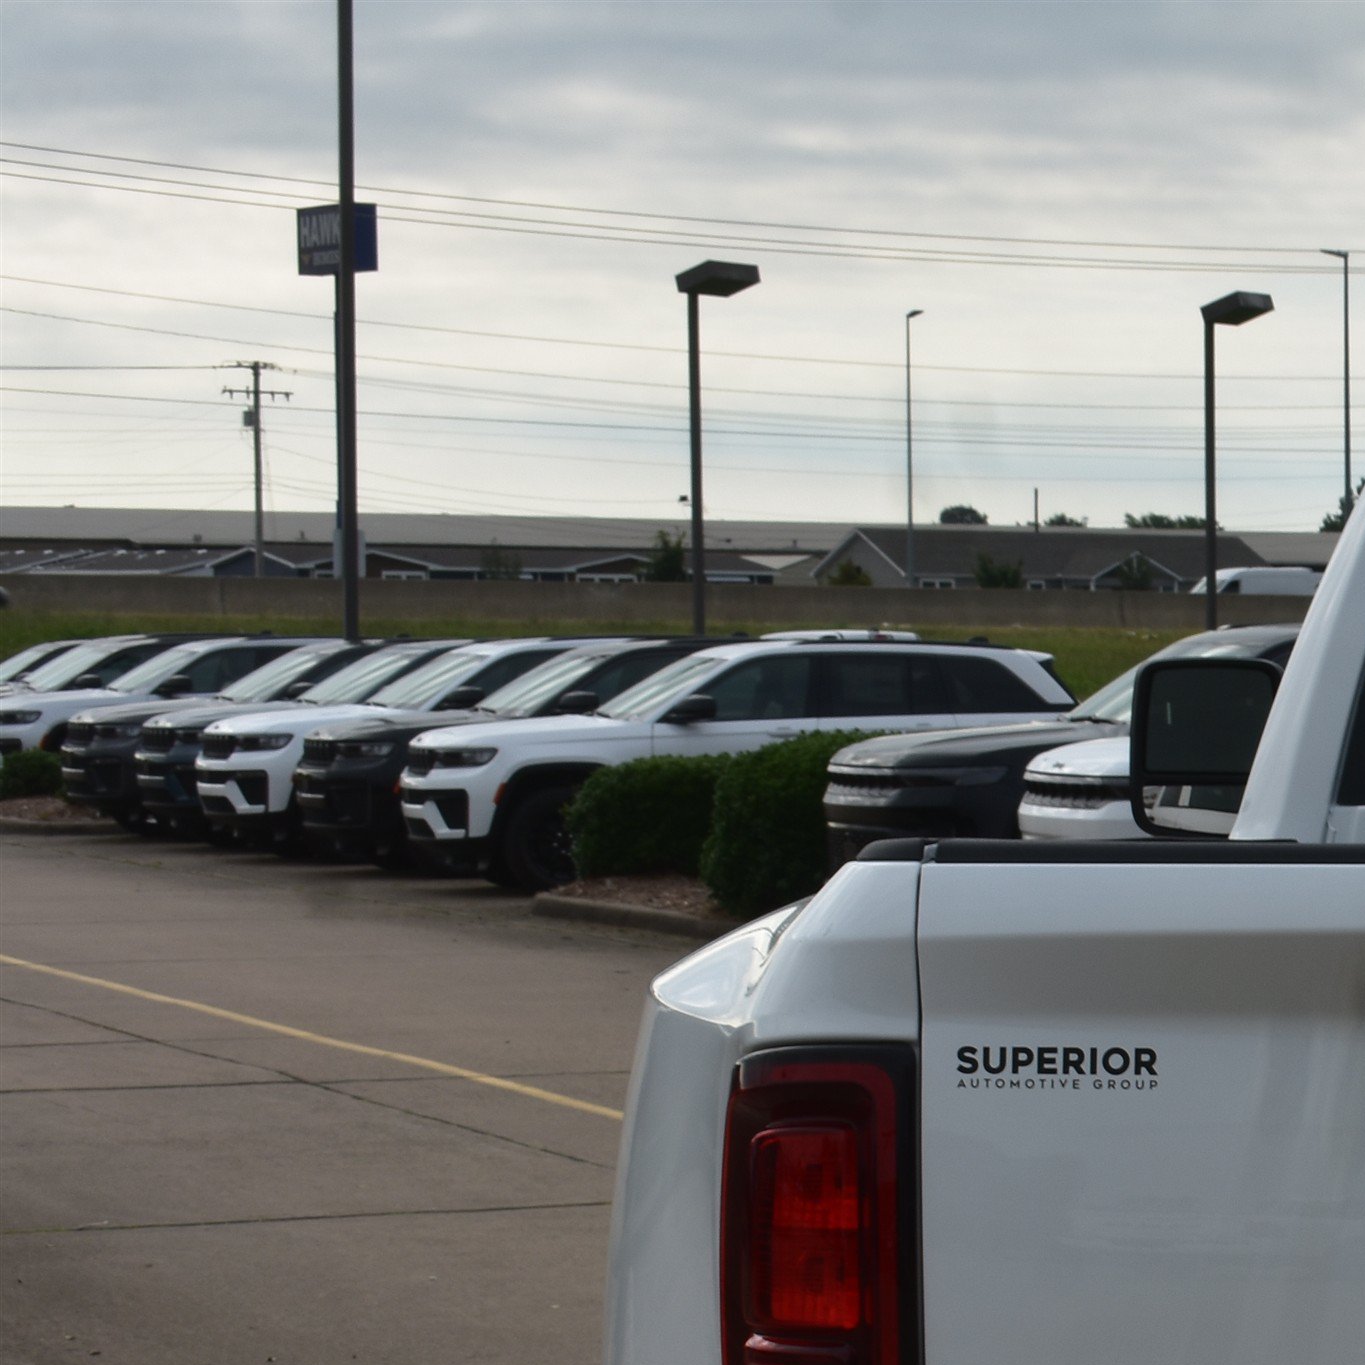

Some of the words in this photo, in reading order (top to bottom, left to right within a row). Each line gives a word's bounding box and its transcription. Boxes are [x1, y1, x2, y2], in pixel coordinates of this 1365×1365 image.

[957, 1046, 1158, 1075] SUPERIOR
[957, 1078, 1080, 1089] AUTOMOTIVE
[1093, 1078, 1158, 1090] GROUP
